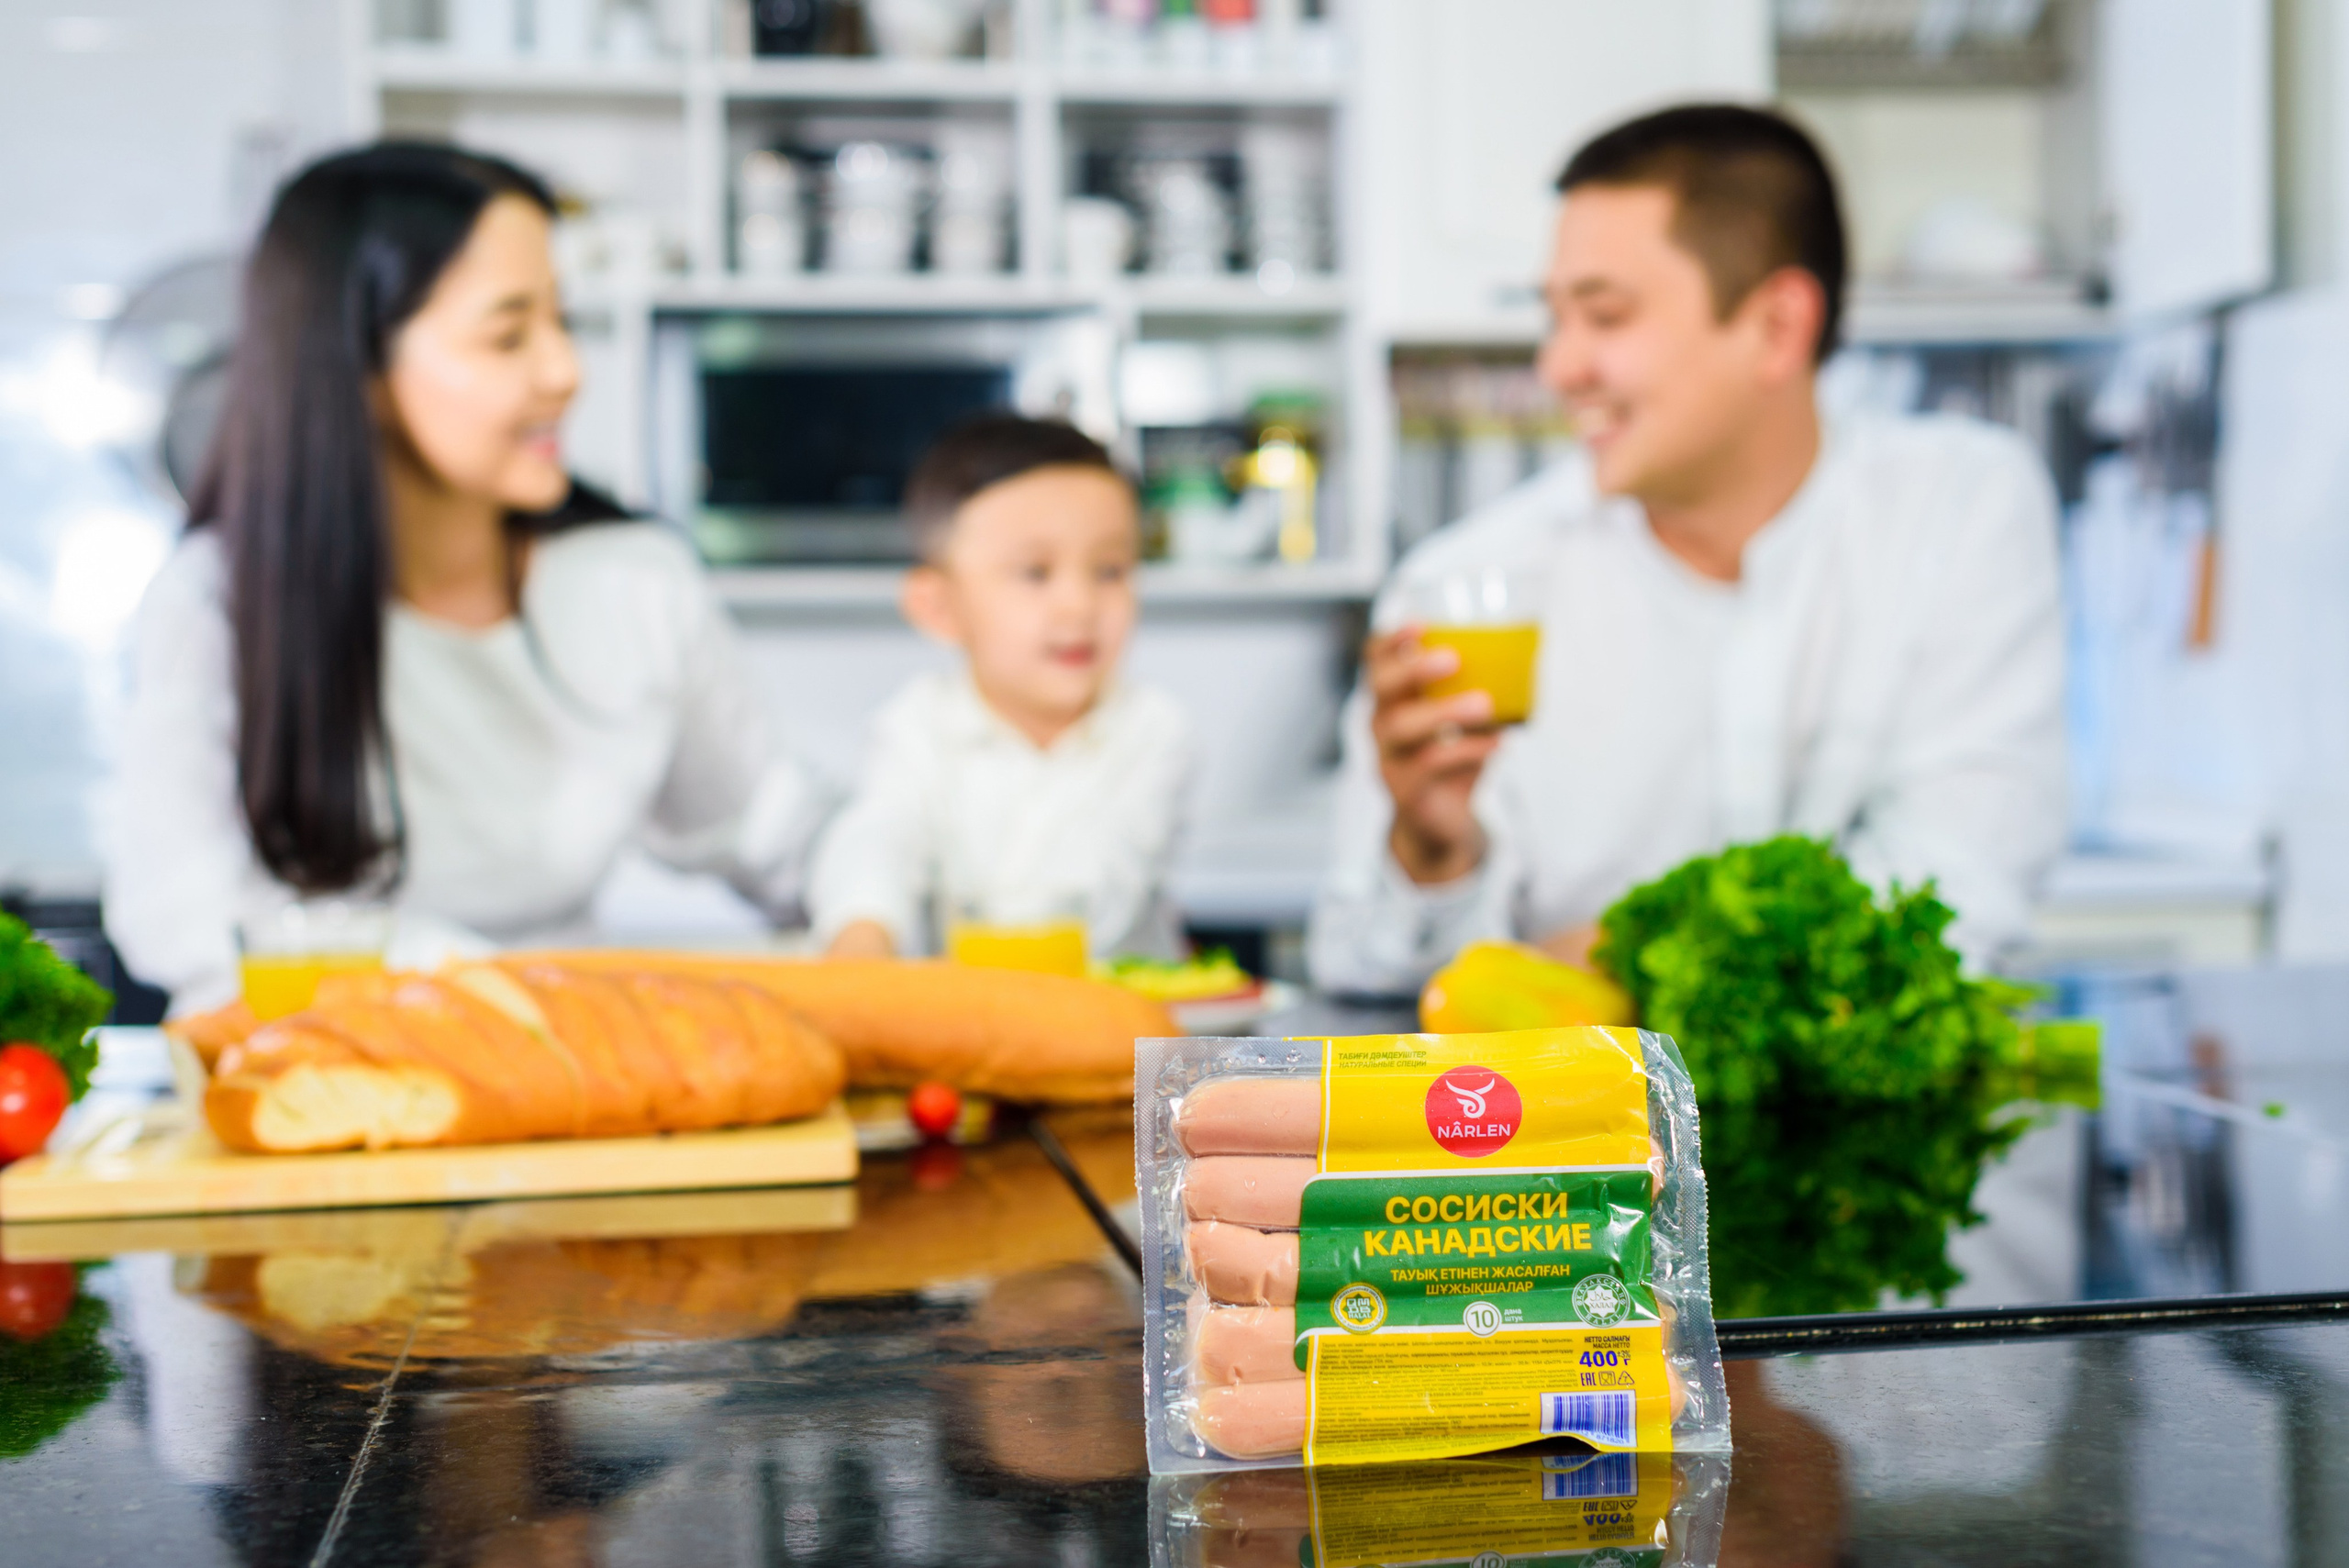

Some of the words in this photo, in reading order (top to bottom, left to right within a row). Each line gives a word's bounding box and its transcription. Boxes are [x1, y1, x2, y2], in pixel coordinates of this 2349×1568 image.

[1339, 1052, 1368, 1061] ТАБИҒИ
[1397, 1060, 1427, 1068] СПЕЦИИ
[1437, 1121, 1510, 1139] NÂRLEN
[1385, 1192, 1568, 1224] СОСИСКИ
[1364, 1223, 1592, 1258] КАНАДСКИЕ
[1390, 1268, 1439, 1283] ТАУЫҚ
[1441, 1266, 1489, 1280] ЕТІНЕН
[1492, 1264, 1570, 1279] ЖАСАЛҒАН
[1426, 1281, 1533, 1296] ШҰЖЫҚШАЛАР
[1471, 1309, 1495, 1329] 10
[1579, 1351, 1618, 1367] 400
